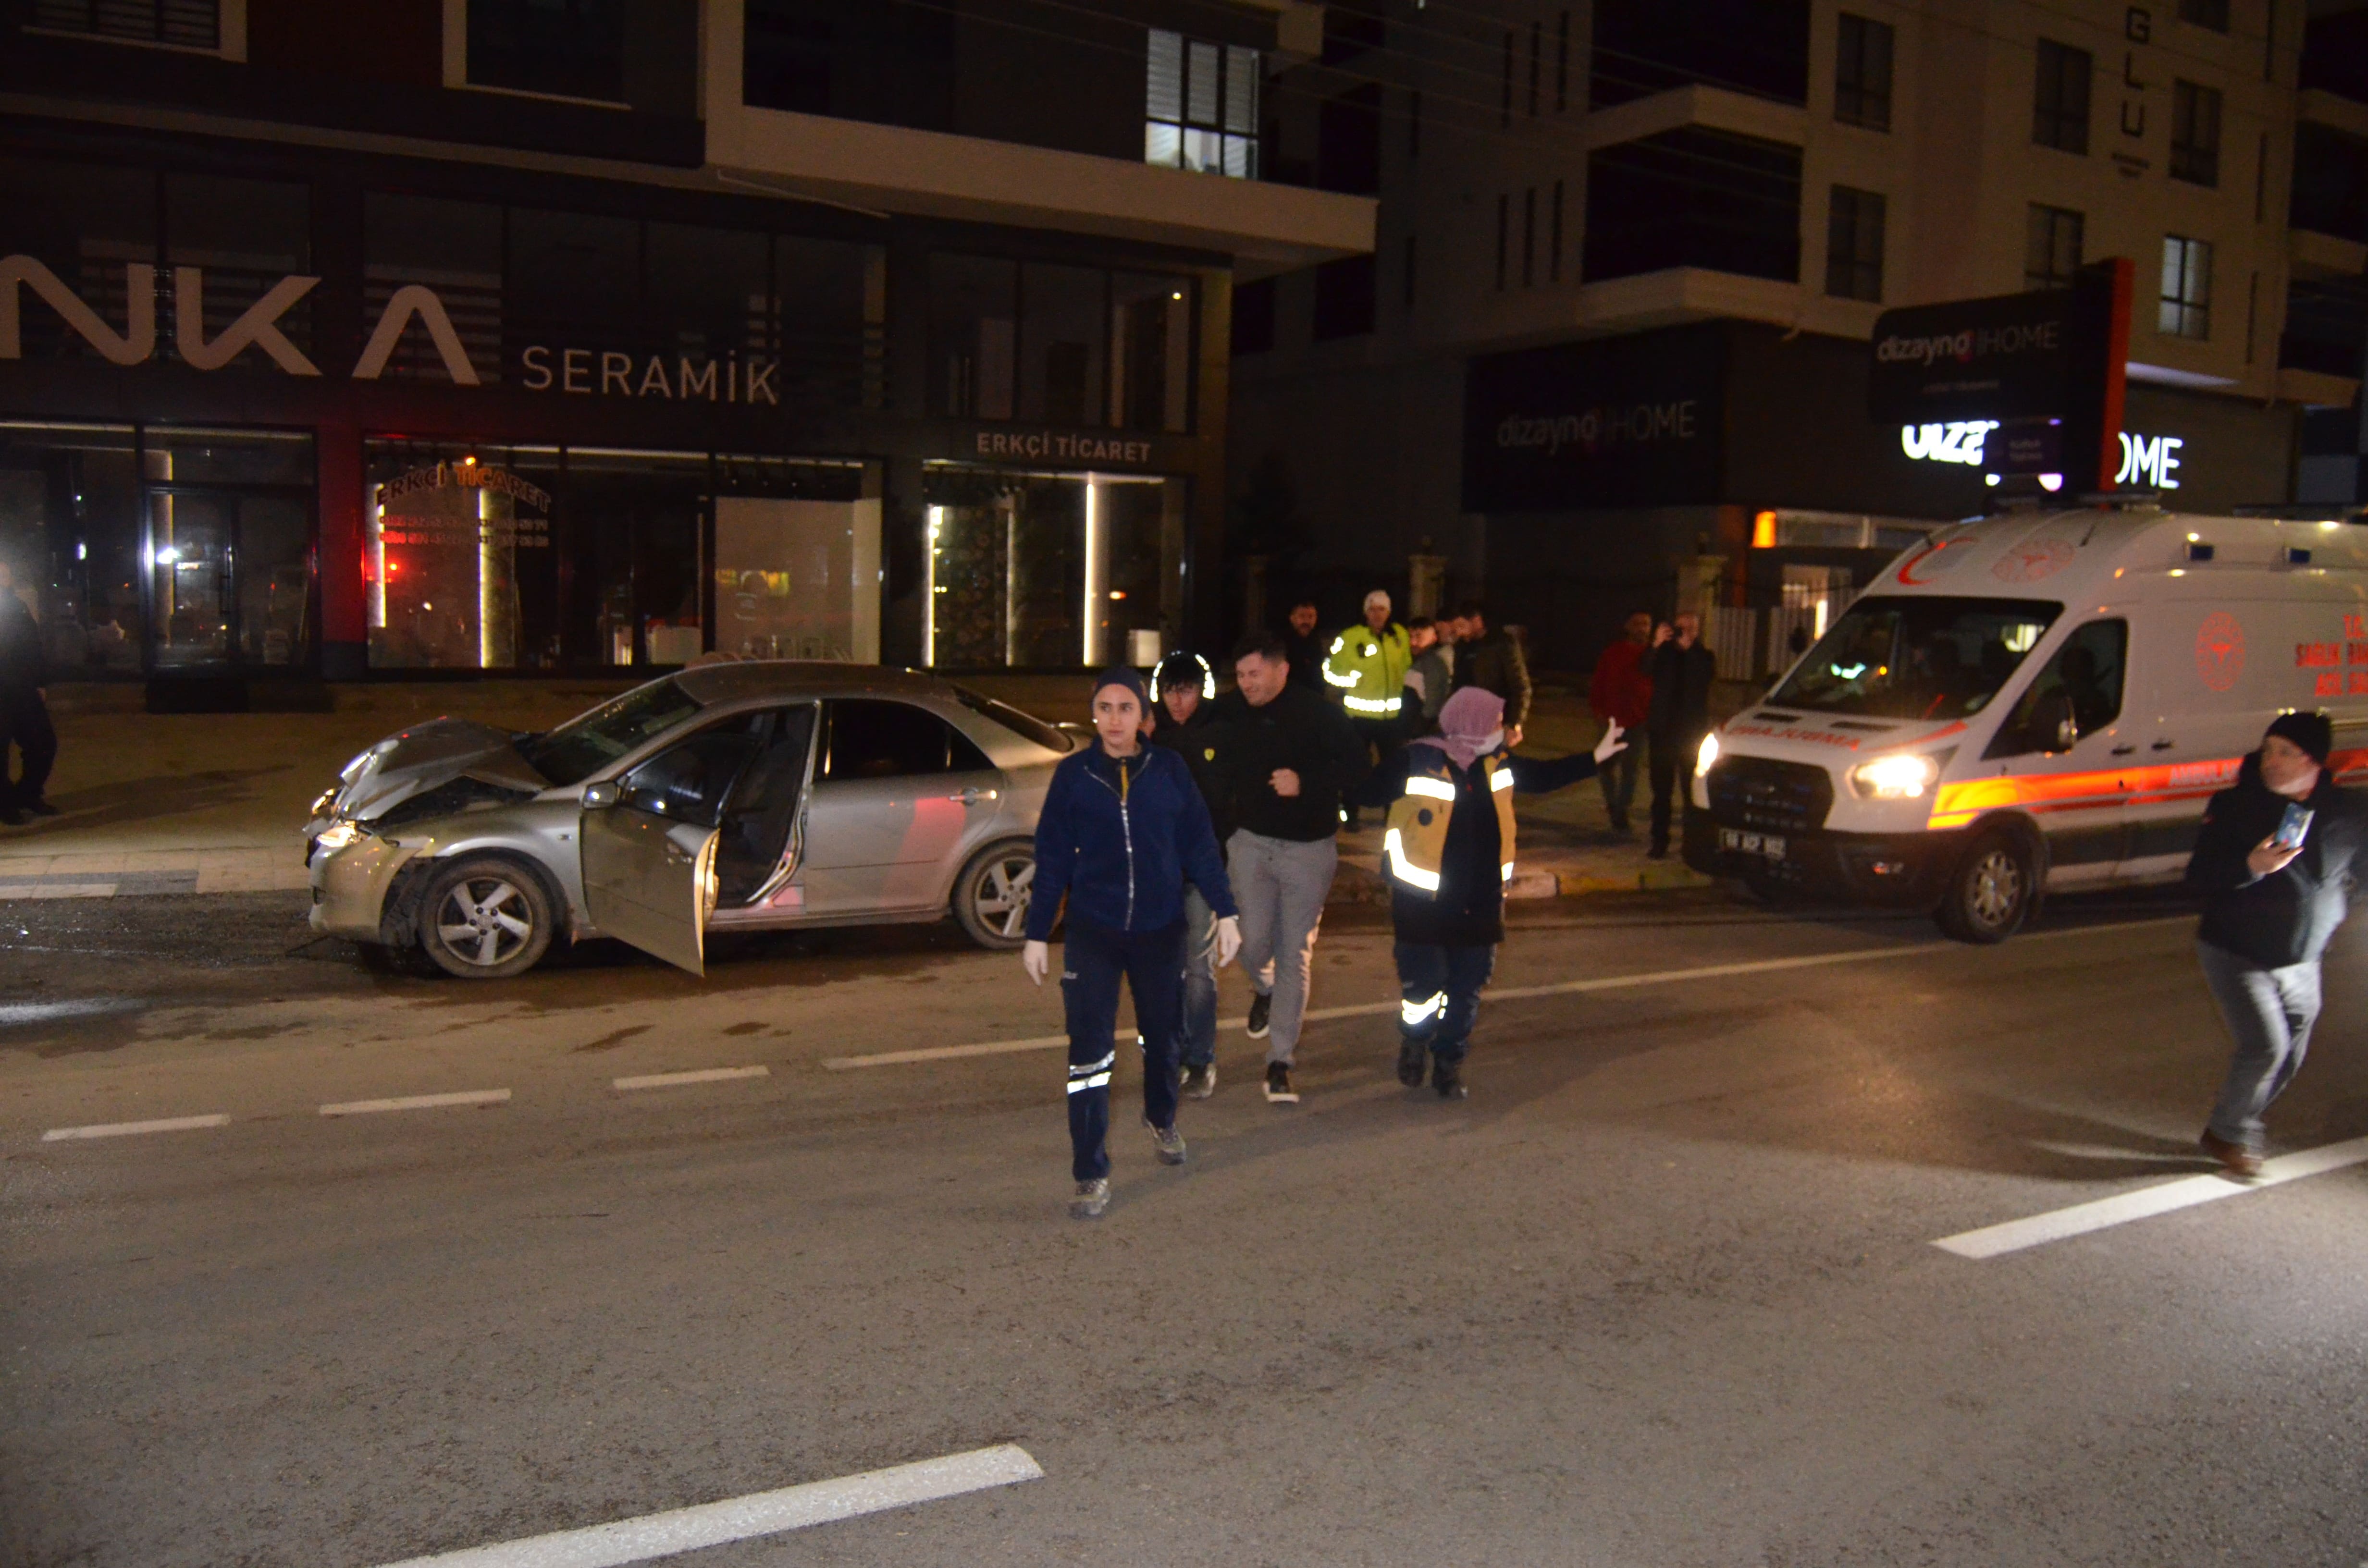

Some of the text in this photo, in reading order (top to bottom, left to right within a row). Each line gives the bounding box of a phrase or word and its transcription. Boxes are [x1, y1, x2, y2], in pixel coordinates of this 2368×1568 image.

[522, 345, 778, 406] SERAMİK
[976, 431, 1151, 463] ERKÇİ TİCARET
[452, 463, 552, 514] TİCARET
